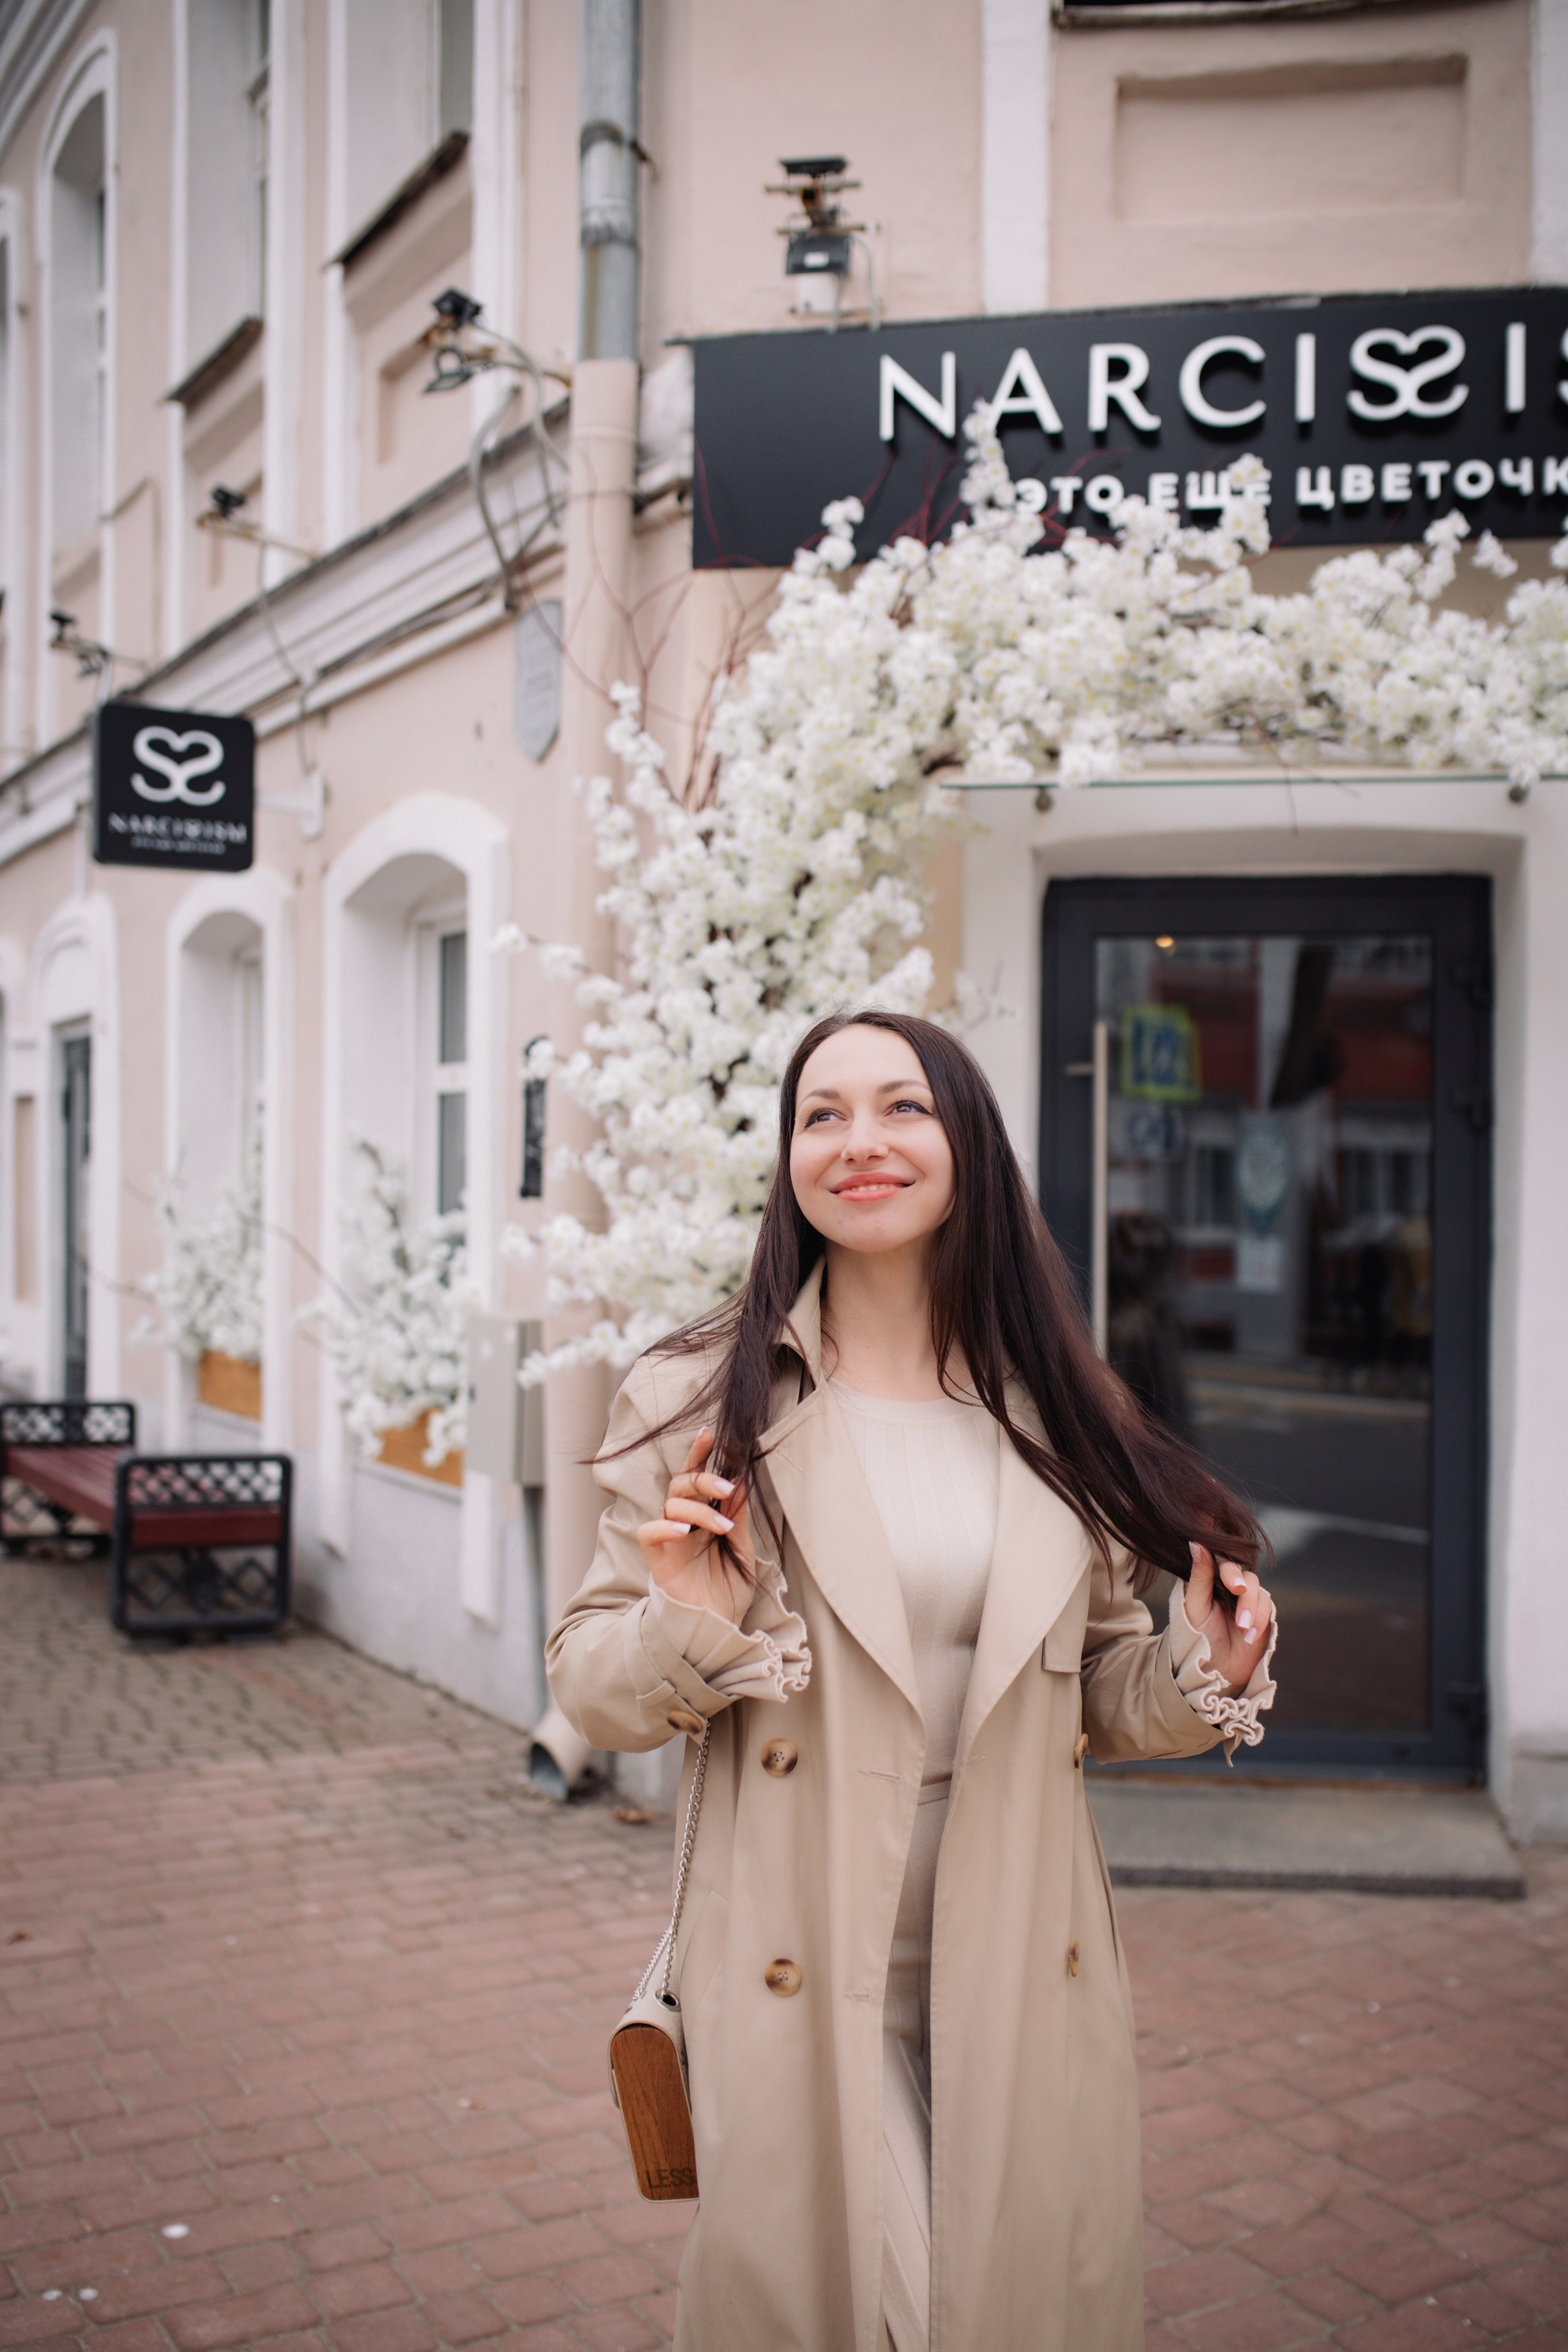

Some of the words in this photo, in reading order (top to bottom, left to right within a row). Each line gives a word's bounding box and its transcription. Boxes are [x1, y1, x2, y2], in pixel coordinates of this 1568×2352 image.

[879, 321, 1568, 441] NARCISSI
[1016, 473, 1125, 514] ЭТО
[1295, 456, 1568, 510] ЦВЕТОЧК
[645, 2167, 695, 2188] LESS
